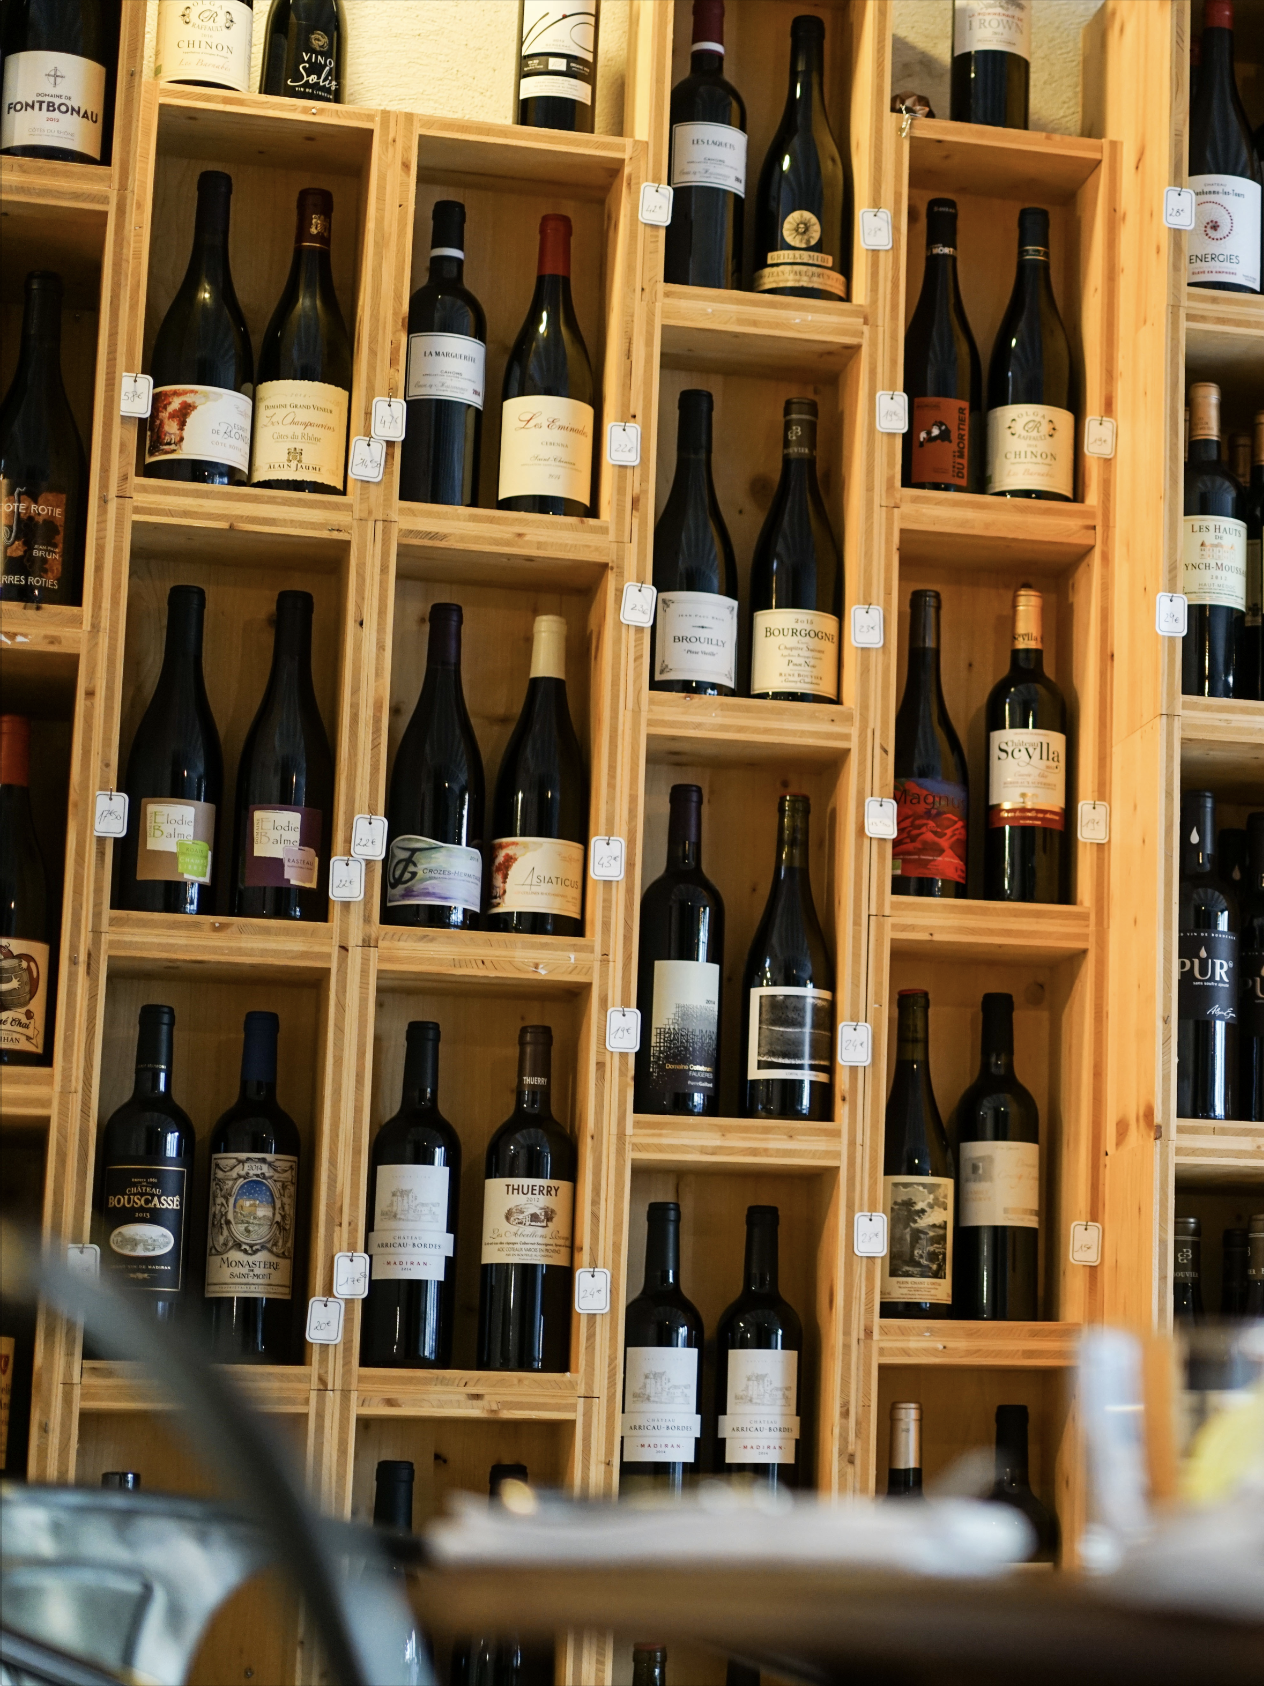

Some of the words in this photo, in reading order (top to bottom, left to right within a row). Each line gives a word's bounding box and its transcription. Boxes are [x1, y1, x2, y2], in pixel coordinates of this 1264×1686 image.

[177, 40, 234, 55] CHINON
[302, 52, 334, 68] VINO
[287, 63, 339, 91] Solis
[36, 92, 63, 100] DOMAINE
[7, 100, 98, 124] FONTBONAU
[692, 138, 706, 146] LES
[770, 252, 805, 262] GRILLE
[807, 253, 830, 264] MIDI
[1189, 252, 1240, 265] ENERGIES
[424, 350, 435, 358] LA
[436, 351, 476, 364] MARGUERITE
[264, 403, 288, 411] DOMAINE
[289, 402, 312, 410] GRAND
[312, 404, 333, 414] VENEUR
[1016, 410, 1046, 420] OLGA
[514, 410, 543, 431] Les
[547, 415, 588, 439] Eminades
[211, 428, 220, 436] DE
[272, 431, 287, 441] Côtes
[289, 432, 299, 441] du
[301, 432, 322, 443] Rhône
[955, 405, 967, 460] MORTIER
[1004, 450, 1057, 462] CHINON
[267, 463, 291, 471] ALAIN
[31, 505, 62, 518] ROTIE
[1191, 524, 1210, 533] LES
[1214, 524, 1242, 538] HAUTS
[33, 550, 59, 560] BRUN
[28, 576, 58, 589] ROTIES
[673, 635, 727, 648] BROUILLY
[764, 627, 836, 644] BOURGOGNE
[997, 741, 1061, 768] Scylla
[153, 810, 193, 826] Elodie
[260, 818, 299, 833] Elodie
[152, 825, 192, 840] Balme
[259, 831, 298, 847] Balme
[287, 857, 314, 867] RASTEAU
[513, 866, 579, 891] ASIATICUS
[10, 1017, 31, 1030] Chai
[126, 1186, 162, 1196] CHÂTEAU
[505, 1183, 560, 1198] THUERRY
[107, 1195, 180, 1210] BOUSCASSÉ
[377, 1242, 442, 1251] ARRICAU-BORDES
[229, 1270, 272, 1281] SAINT-MONT
[629, 1424, 693, 1432] ARRICAU-BORDES
